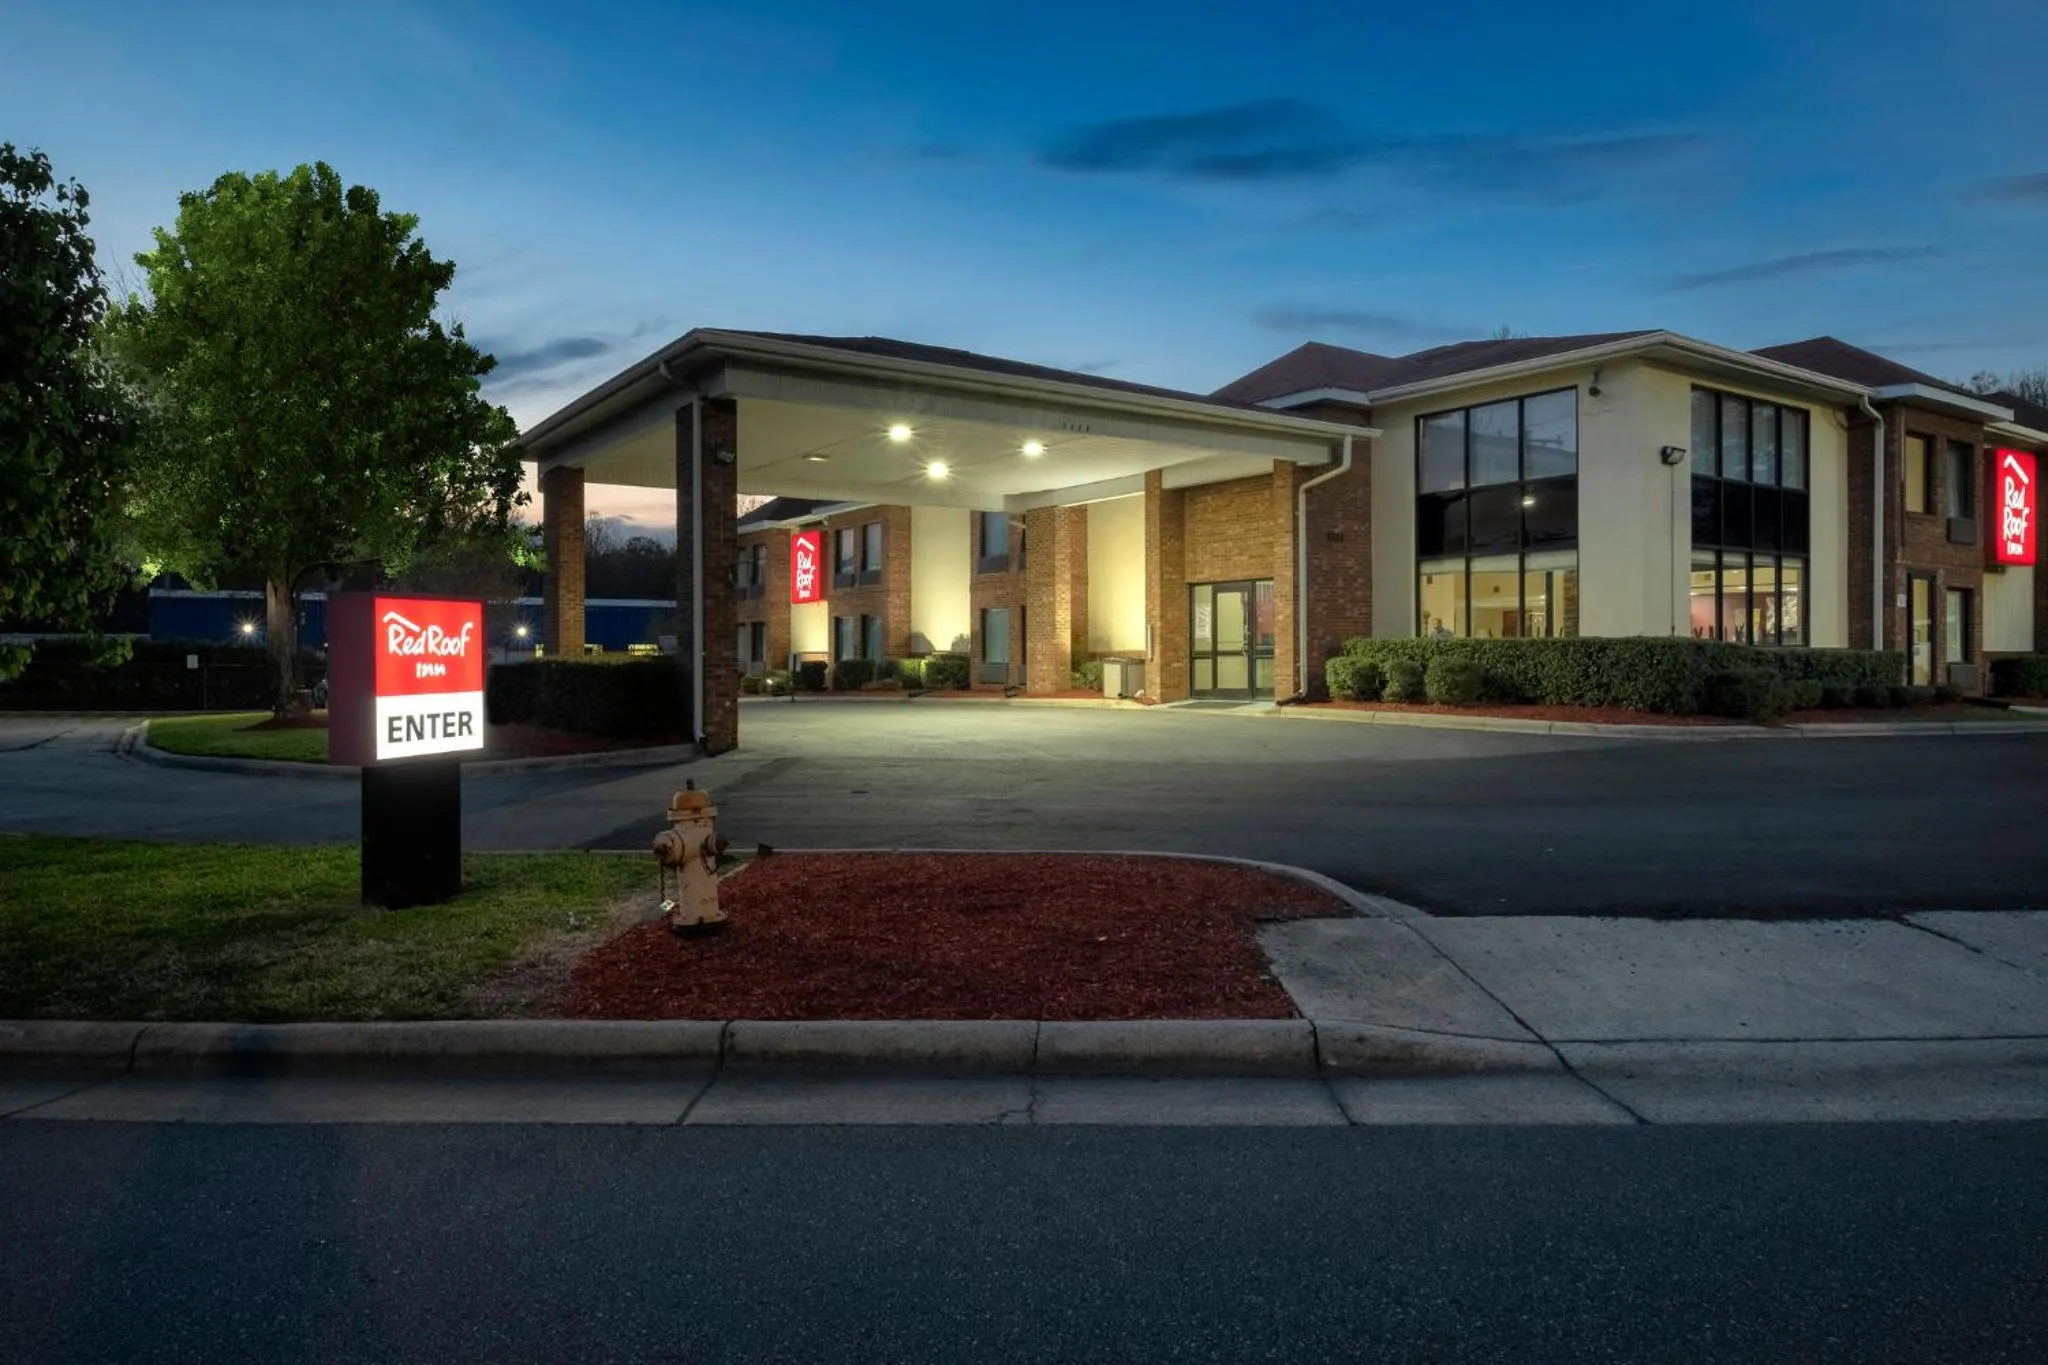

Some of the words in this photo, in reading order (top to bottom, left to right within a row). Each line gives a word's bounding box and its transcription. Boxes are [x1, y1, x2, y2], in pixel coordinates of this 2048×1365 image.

[2005, 476, 2026, 509] Red
[2003, 506, 2030, 543] Roof
[797, 550, 812, 569] Red
[796, 565, 816, 591] Roof
[387, 711, 473, 744] ENTER
